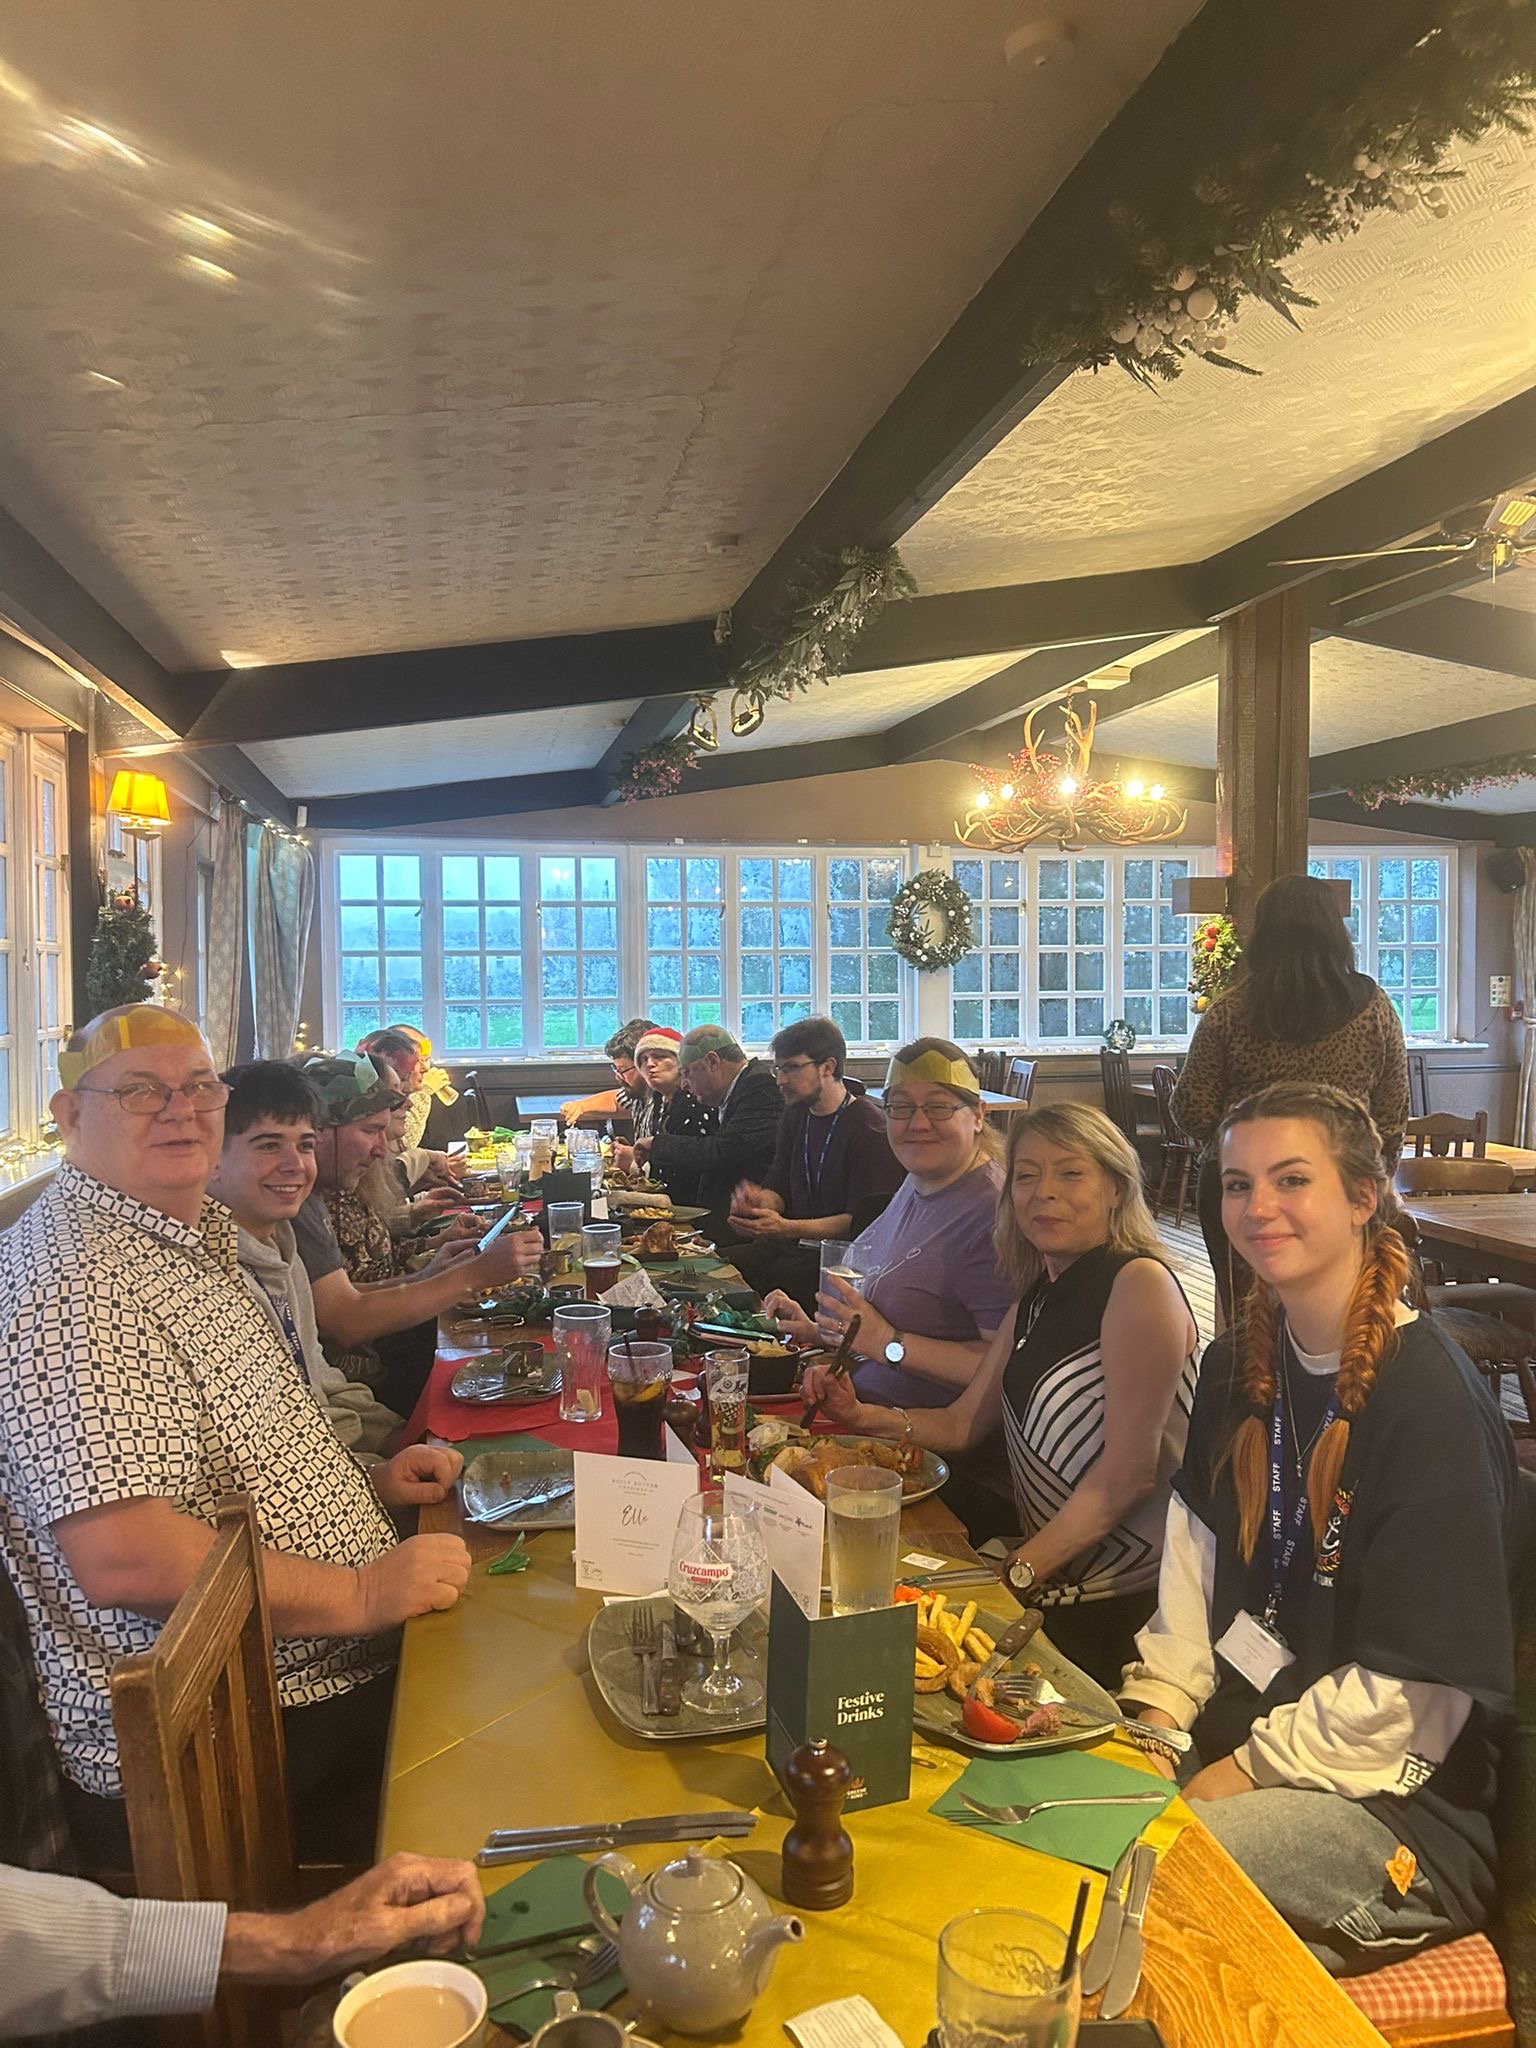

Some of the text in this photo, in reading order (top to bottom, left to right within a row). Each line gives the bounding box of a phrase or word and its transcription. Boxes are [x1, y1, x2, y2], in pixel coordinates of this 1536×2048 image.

[1273, 1416, 1283, 1446] STAFF
[1272, 1462, 1281, 1492] STAFF
[621, 1504, 649, 1527] Elle
[1272, 1509, 1282, 1540] STAFF
[1294, 1496, 1308, 1526] STAFF
[1281, 1539, 1296, 1567] STAFF
[679, 1560, 729, 1579] Cruzcampo
[837, 1691, 885, 1710] Festive
[837, 1706, 884, 1725] Drinks
